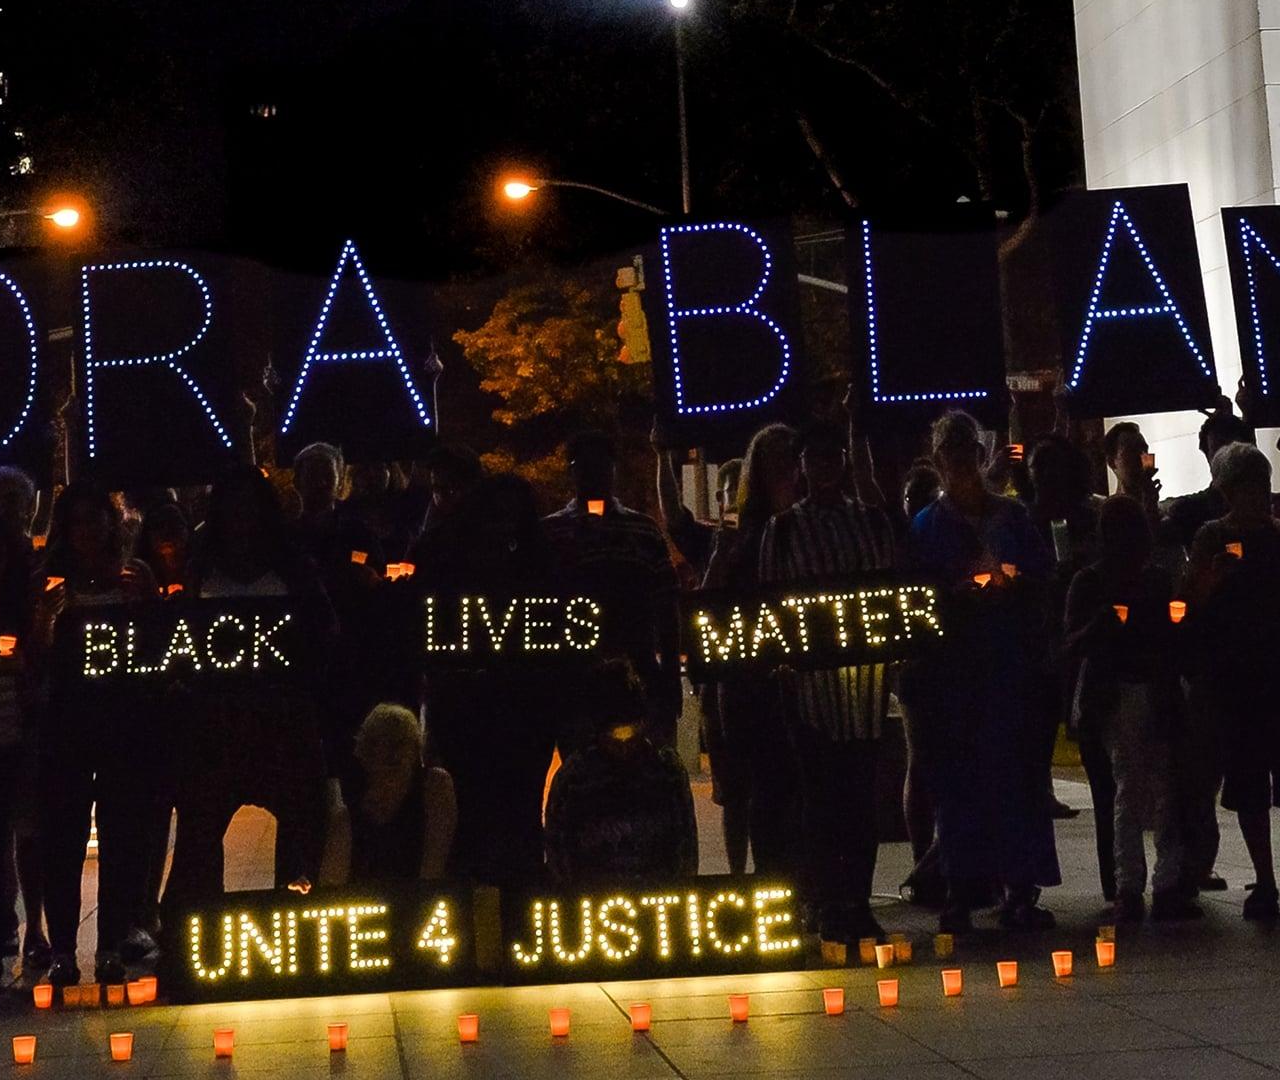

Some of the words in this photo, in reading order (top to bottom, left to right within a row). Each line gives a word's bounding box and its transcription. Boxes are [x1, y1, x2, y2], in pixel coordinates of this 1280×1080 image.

[83, 614, 291, 676] BLACK
[425, 596, 600, 651] LIVES
[696, 586, 944, 663] MATTER
[189, 903, 390, 980] UNITE
[418, 901, 457, 964] 4
[513, 886, 801, 965] JUSTICE
